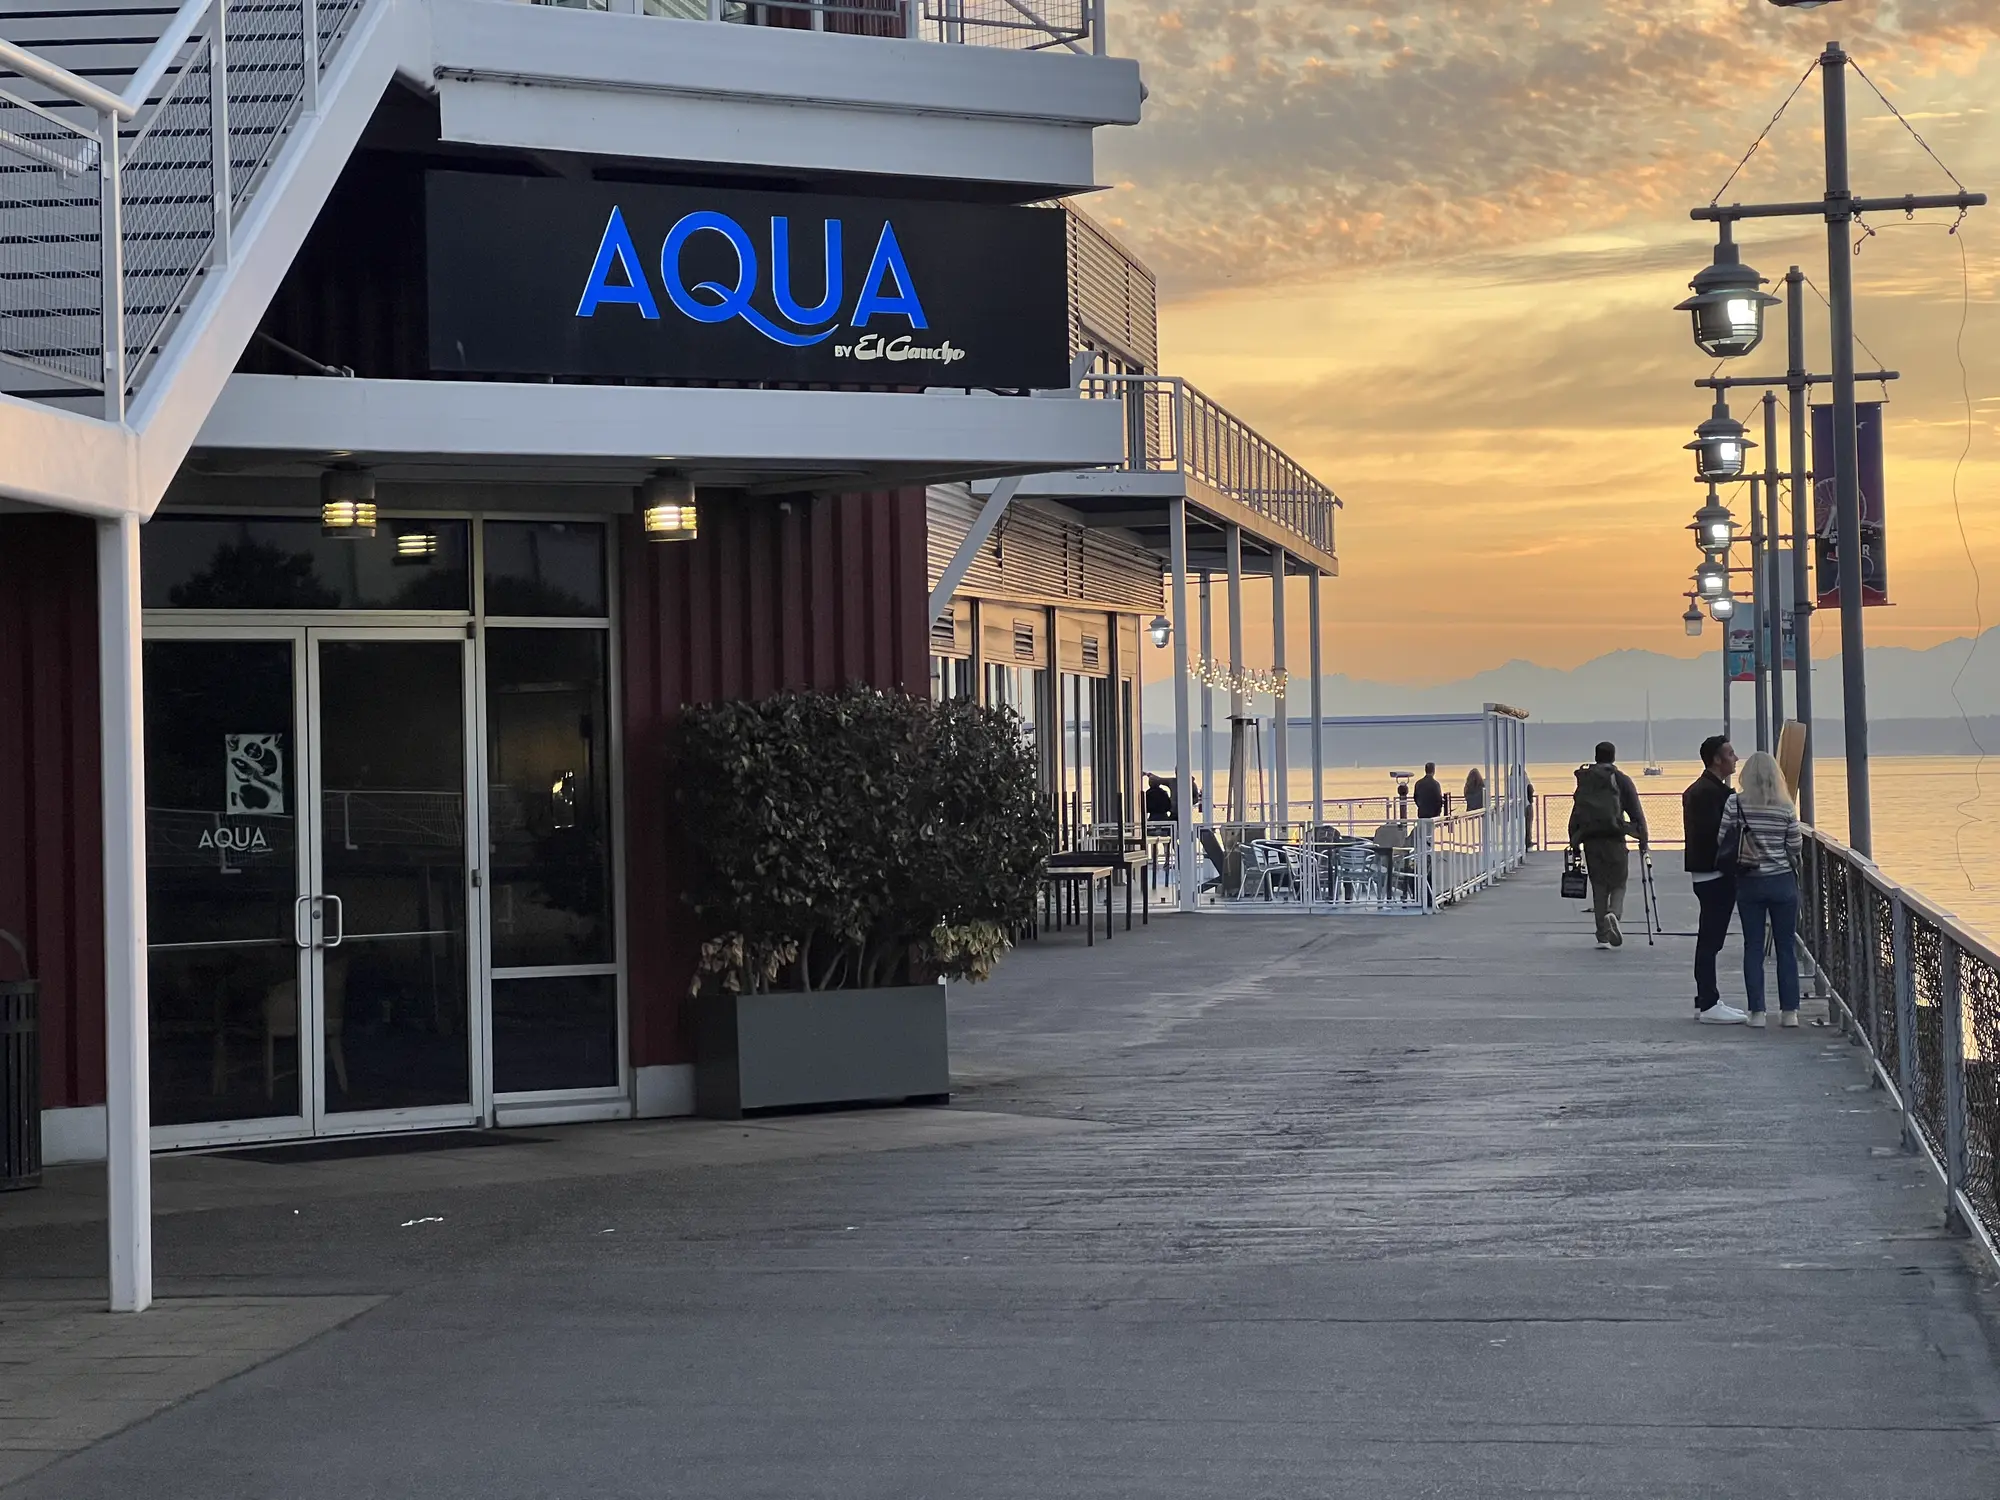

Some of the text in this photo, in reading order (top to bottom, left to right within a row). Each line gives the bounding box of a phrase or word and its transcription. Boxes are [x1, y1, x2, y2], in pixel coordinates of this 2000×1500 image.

[576, 205, 928, 347] AQUA
[834, 333, 965, 365] BY El Gaucho
[198, 827, 267, 851] AQUA
